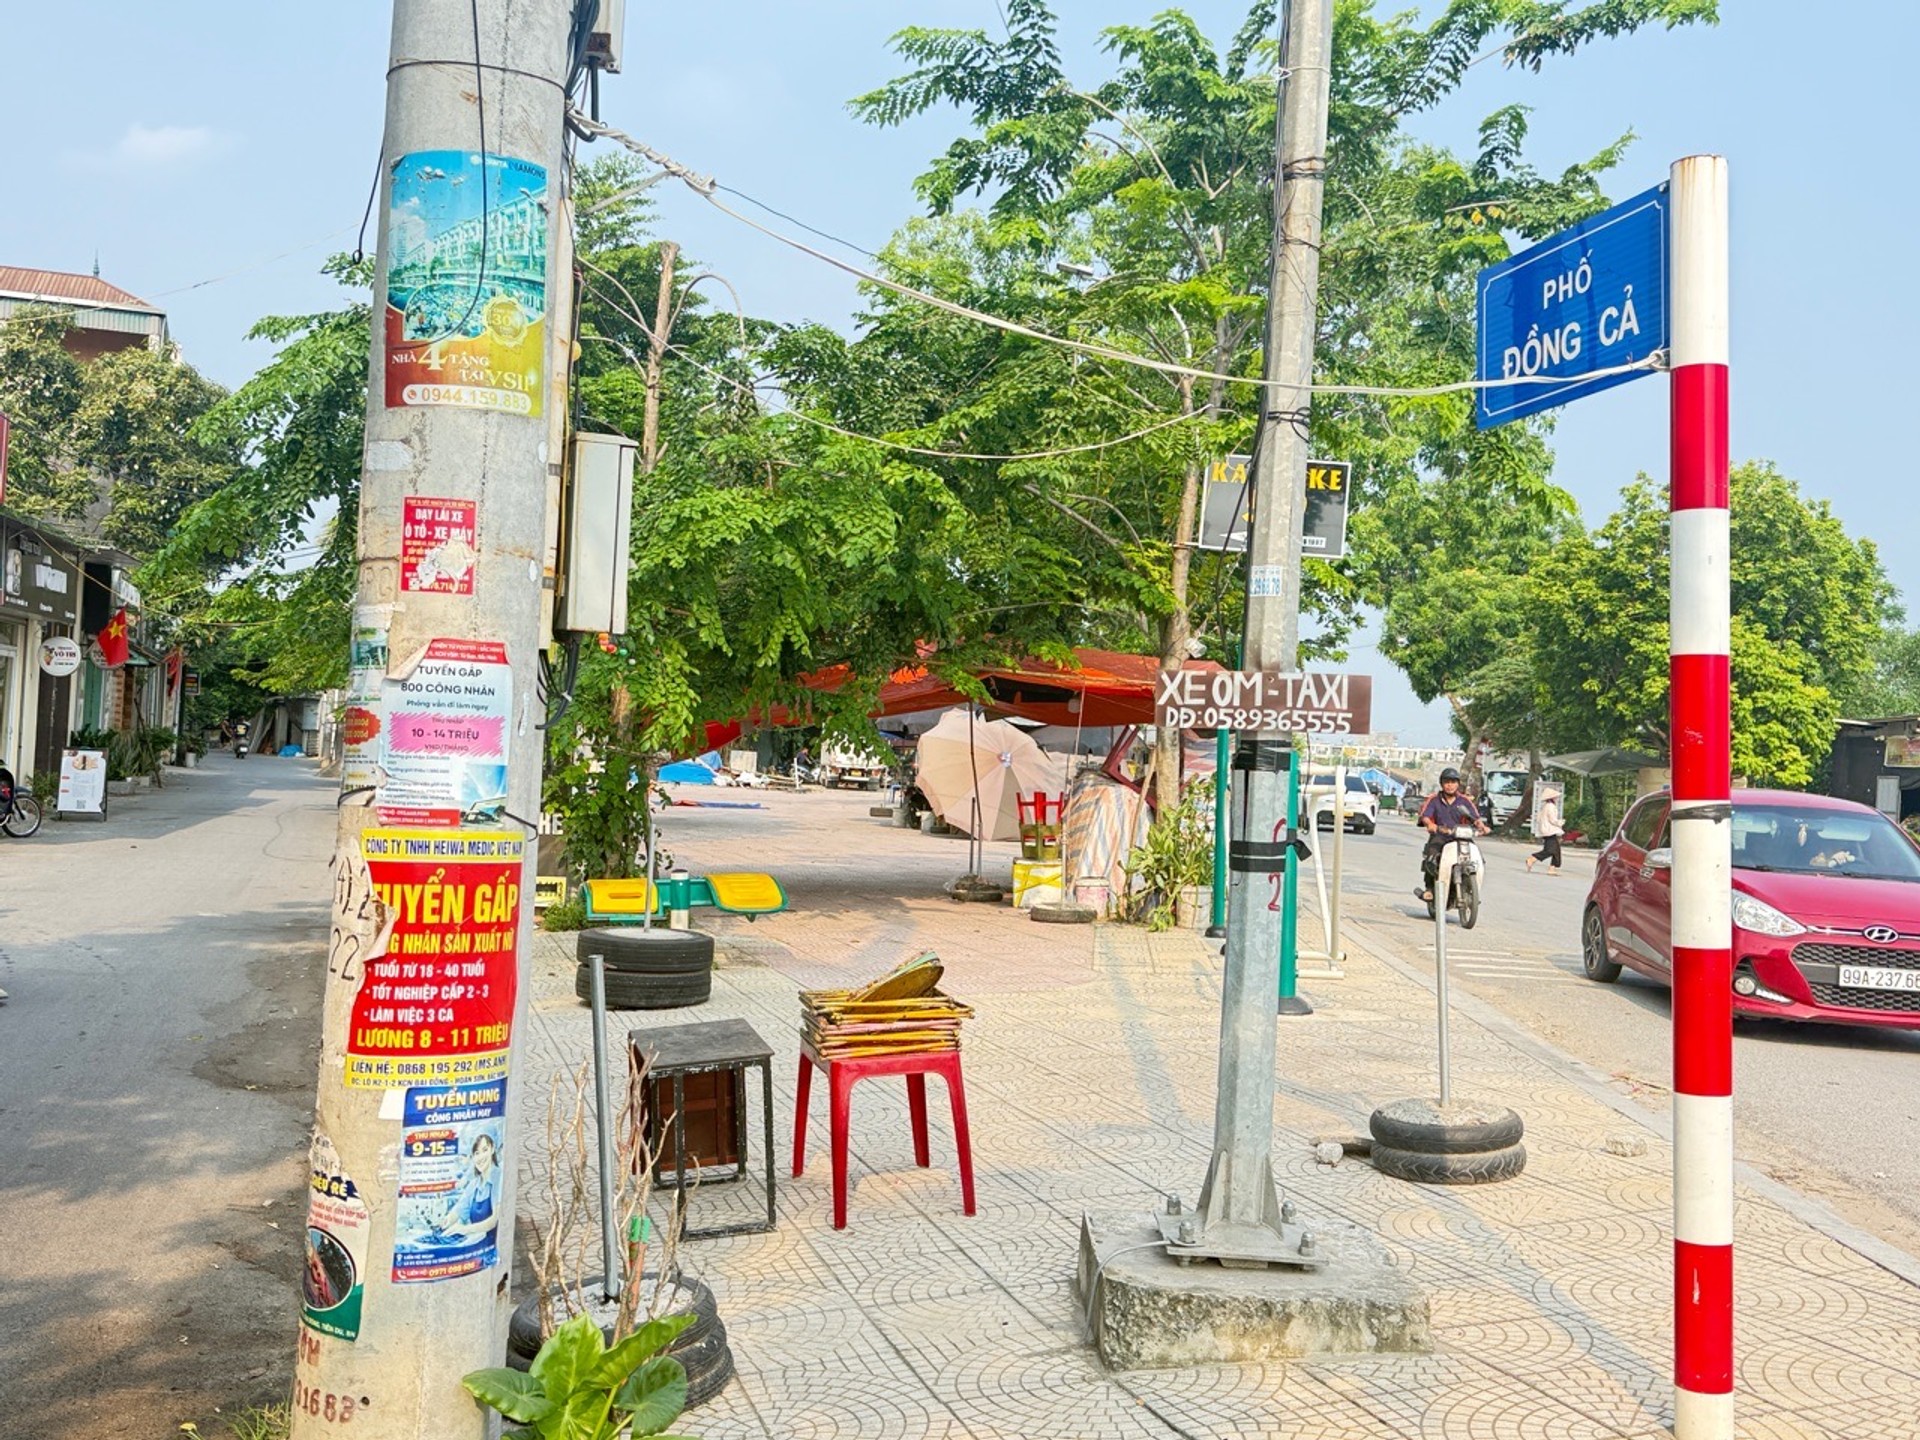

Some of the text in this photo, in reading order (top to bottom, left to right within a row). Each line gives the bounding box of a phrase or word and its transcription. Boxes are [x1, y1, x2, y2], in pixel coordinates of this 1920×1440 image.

[1543, 248, 1593, 310] PHỐ
[1503, 284, 1641, 379] ĐỒNG CẢ
[391, 350, 417, 365] NHÀ
[418, 339, 447, 371] 4
[451, 510, 464, 523] XE
[433, 526, 449, 540] XE
[401, 682, 495, 696] 800 CÔNG NHÂN
[1157, 671, 1207, 706] XE
[412, 728, 425, 738] 10
[434, 729, 446, 738] 14
[448, 728, 480, 742] TRIỆU
[366, 836, 388, 854] CÔNG
[391, 839, 402, 854] TY
[405, 839, 431, 855] TNHH
[433, 840, 465, 855] HEIWA
[468, 841, 495, 856] MEDIC
[474, 870, 519, 924] GẤP
[403, 930, 441, 954] NHÂN
[444, 926, 471, 954] SẢN
[473, 926, 503, 953] XUẤT
[374, 959, 399, 977] TUỔI
[402, 961, 418, 978] TỪ
[420, 964, 434, 977] 18
[444, 963, 459, 977] 40
[461, 957, 485, 977] TUỔI
[372, 982, 391, 999] TỐT
[394, 983, 438, 1003] NGHIỆP
[441, 981, 465, 999] CẤP
[467, 985, 474, 999] 2
[482, 985, 489, 998] 3
[369, 1006, 454, 1025] LÀM VIỆC 3 CA
[357, 1027, 414, 1048] LƯƠNG
[420, 1030, 432, 1047] 8
[451, 1028, 469, 1047] 11
[475, 1021, 509, 1046] TRIỆU
[351, 1059, 373, 1073] LIÊN
[397, 1062, 426, 1075] 0868
[431, 1062, 450, 1074] 195
[453, 1060, 473, 1073] 292
[415, 1087, 500, 1111] TUYỂN DỤNG
[425, 1112, 451, 1124] CÔNG
[452, 1109, 477, 1121] NHÂN
[412, 1141, 446, 1156] 9-15
